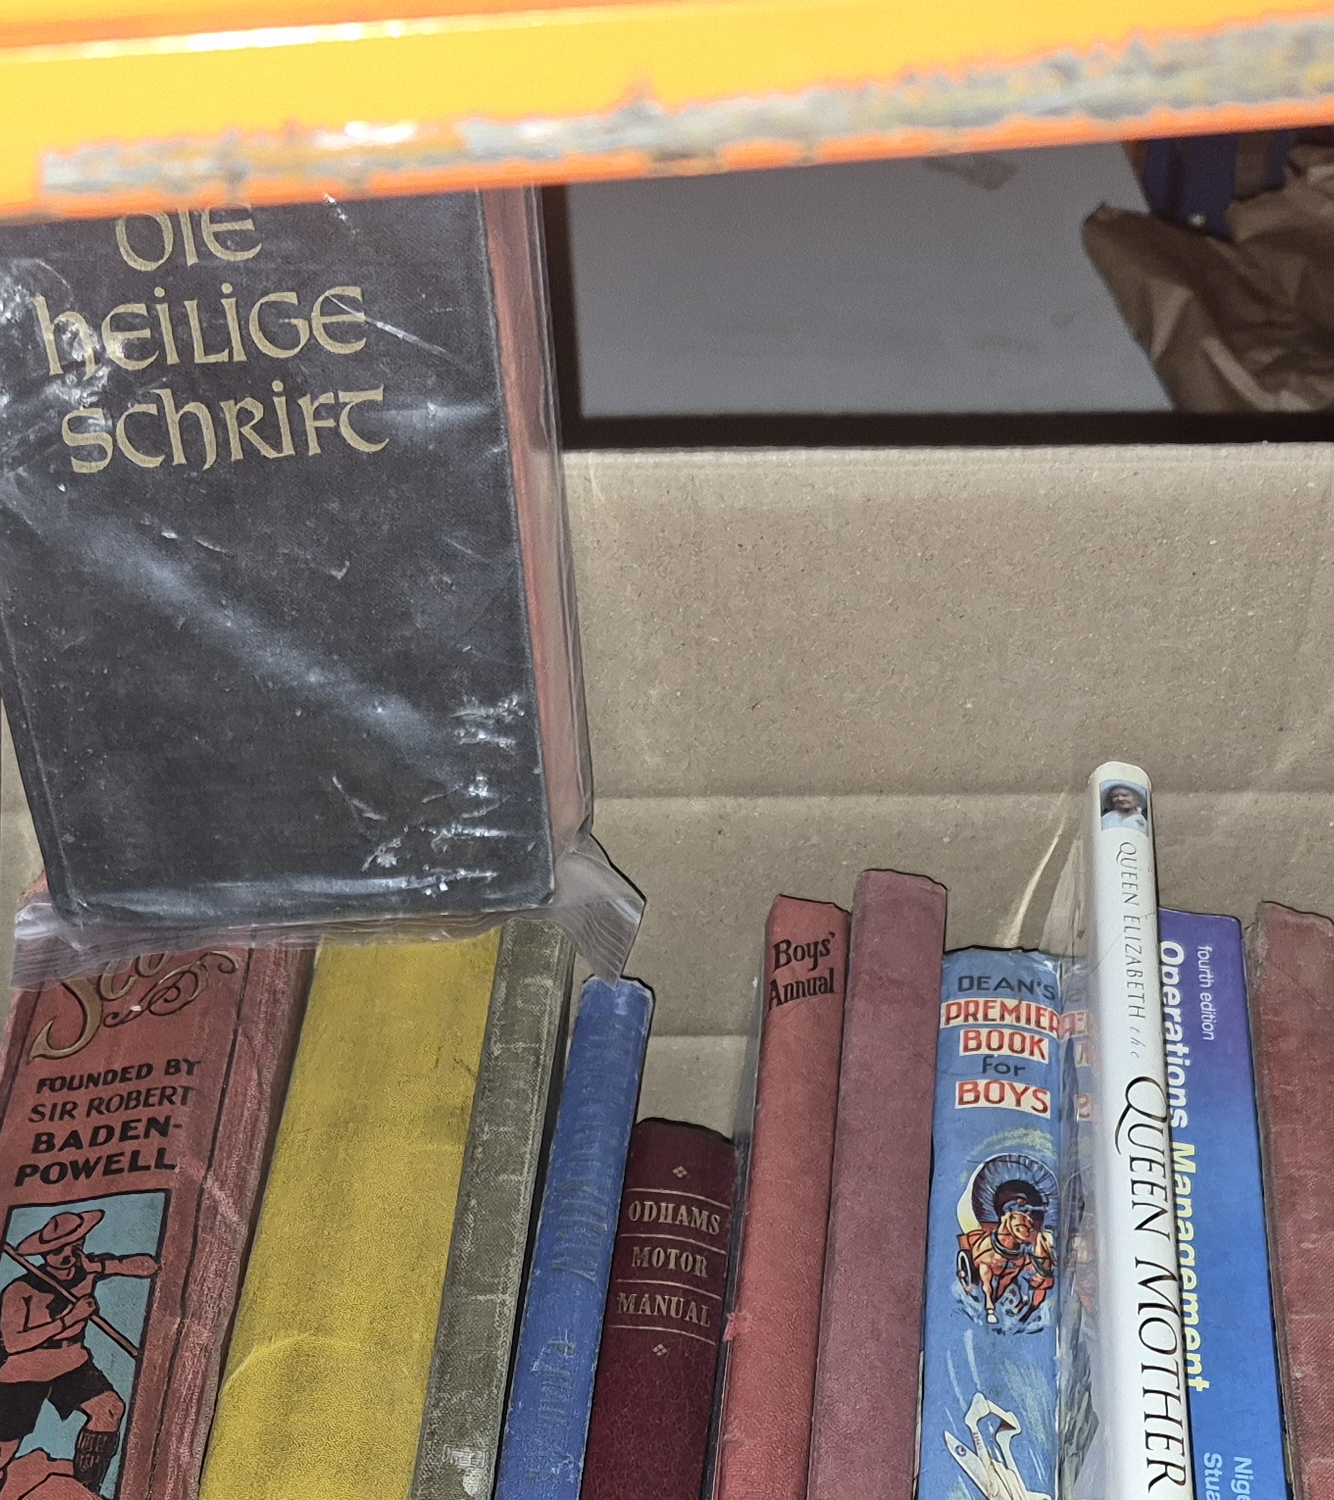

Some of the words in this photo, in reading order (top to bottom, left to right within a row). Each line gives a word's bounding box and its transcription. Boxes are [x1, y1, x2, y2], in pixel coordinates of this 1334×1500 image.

[1119, 841, 1139, 906] QUEEN
[772, 932, 836, 973] Boys'
[1122, 914, 1148, 1020] ELIZABETH
[769, 968, 835, 1010] Annual
[958, 975, 1056, 1001] DEAN'S
[1197, 944, 1214, 1002] fourth
[944, 999, 1061, 1040] PREMIER
[1199, 1004, 1216, 1042] edition
[962, 1029, 1047, 1061] BOOK
[1128, 1024, 1142, 1060] the
[35, 1062, 154, 1094] FOUNDED
[164, 1058, 203, 1077] BY
[27, 1100, 79, 1124] SIR
[85, 1084, 197, 1120] ROBERT
[957, 1080, 1049, 1114] BOYS
[14, 1147, 178, 1188] POWELL
[1114, 1075, 1171, 1239] QUEEN
[628, 1201, 721, 1235] ODHAMS
[630, 1246, 708, 1278] MOTOR
[617, 1292, 711, 1328] MANUAL
[1133, 1256, 1187, 1492] MOTHER
